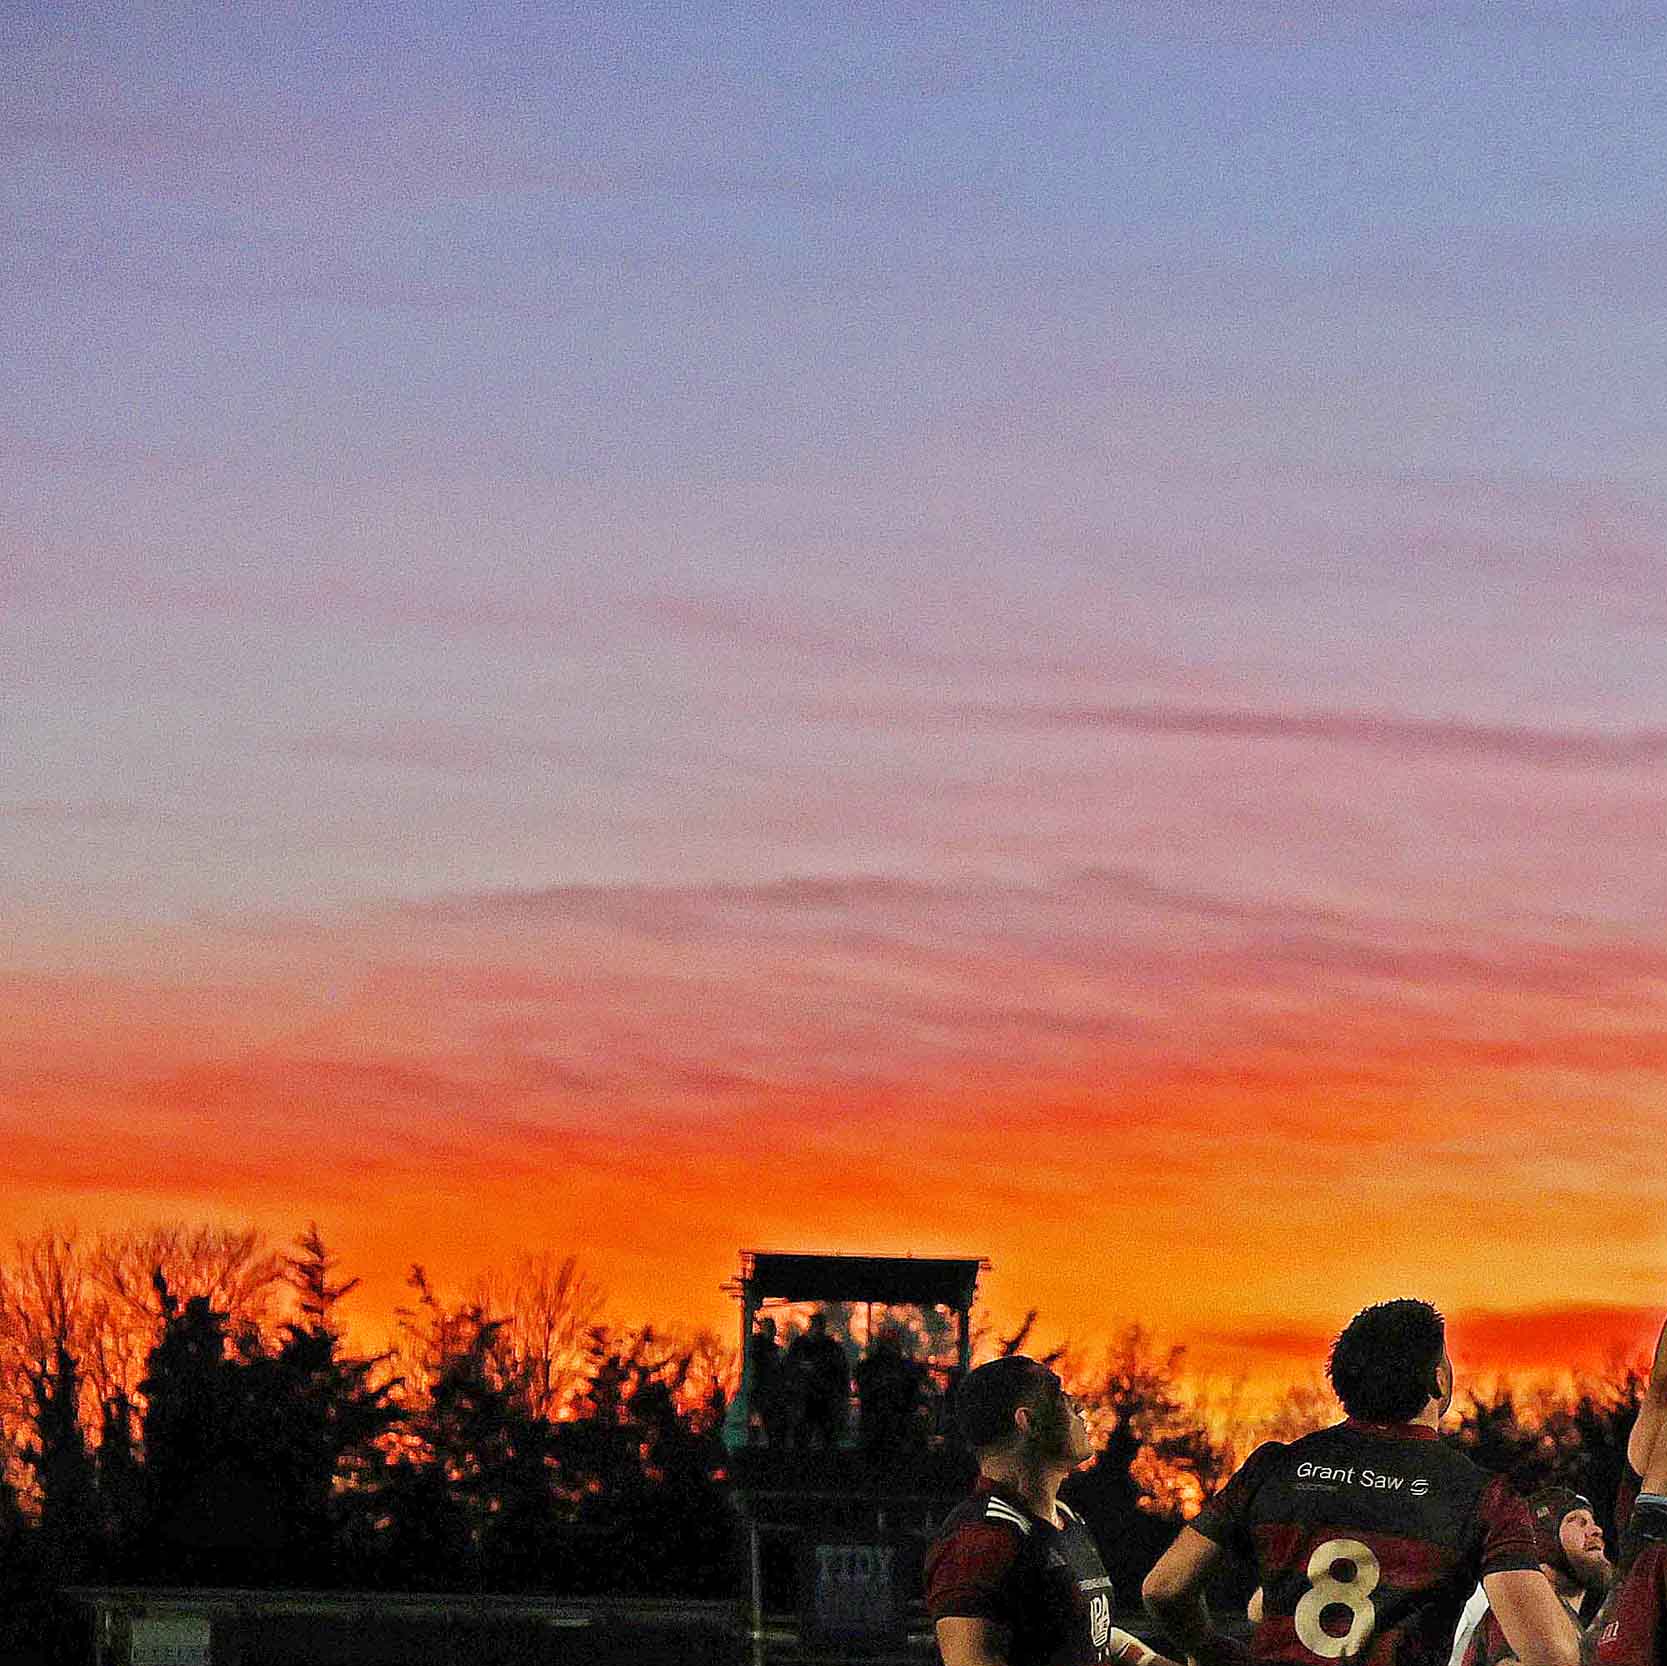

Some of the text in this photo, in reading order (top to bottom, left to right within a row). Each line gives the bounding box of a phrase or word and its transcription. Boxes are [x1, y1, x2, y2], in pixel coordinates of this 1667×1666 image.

[1296, 1461, 1355, 1484] Grant
[1359, 1469, 1405, 1490] Saw
[1295, 1538, 1382, 1659] 8
